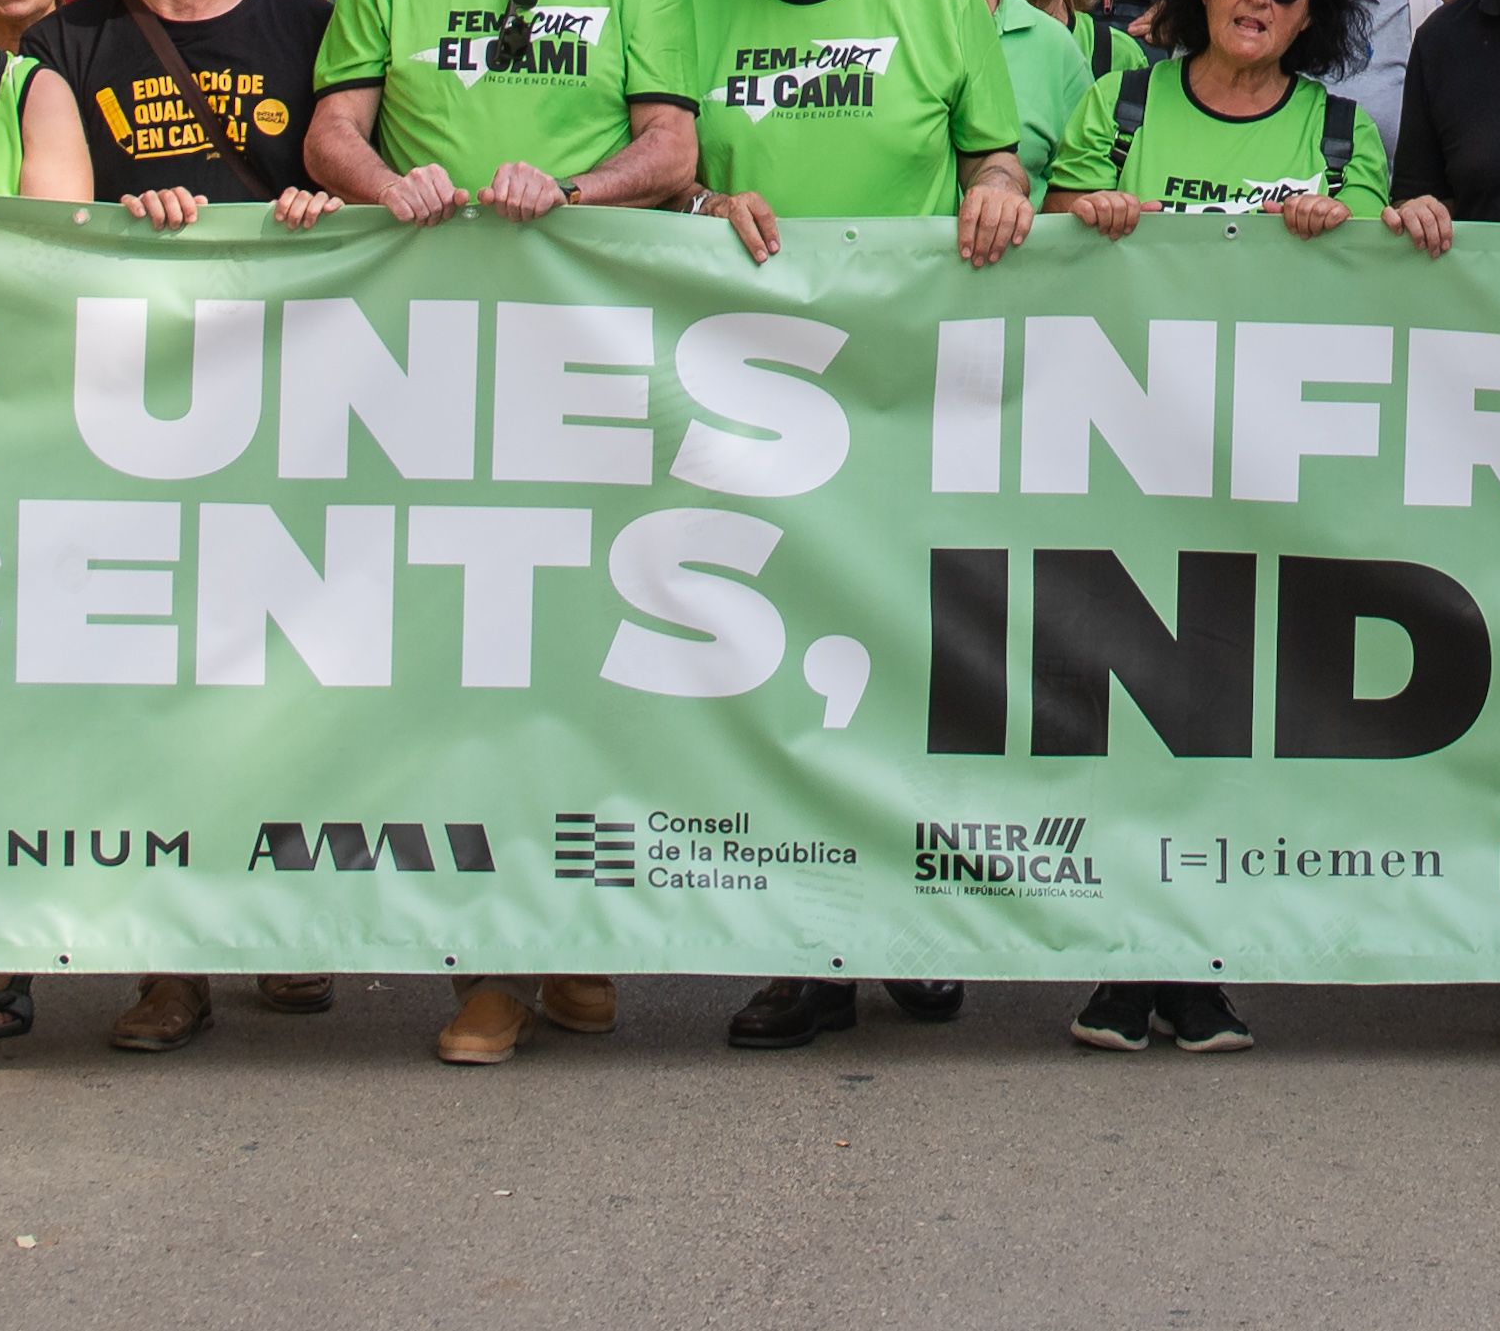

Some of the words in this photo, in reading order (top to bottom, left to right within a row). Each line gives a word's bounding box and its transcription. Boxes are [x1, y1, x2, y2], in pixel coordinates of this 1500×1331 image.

[438, 37, 478, 72] EL
[736, 47, 797, 71] FEM
[132, 68, 232, 101] EDUCIÓ
[237, 74, 265, 95] DE
[483, 74, 588, 88] INDEPENDÈNCIA
[726, 75, 765, 108] EL
[773, 72, 875, 109] CAMÍ
[136, 126, 164, 151] EN
[1164, 176, 1229, 202] FEM
[73, 297, 851, 498] UNES
[647, 811, 750, 836] Consell
[915, 822, 1030, 852] INTER
[647, 840, 681, 862] de
[687, 840, 713, 862] la
[721, 839, 859, 869] República
[647, 866, 769, 892] Catalana
[914, 852, 1102, 885] SINDICAL
[914, 885, 952, 895] TREBALL
[963, 884, 1016, 897] REPÚBLICA
[1025, 886, 1068, 898] JUSTÍCIA
[1069, 888, 1104, 899] SOCIAL
